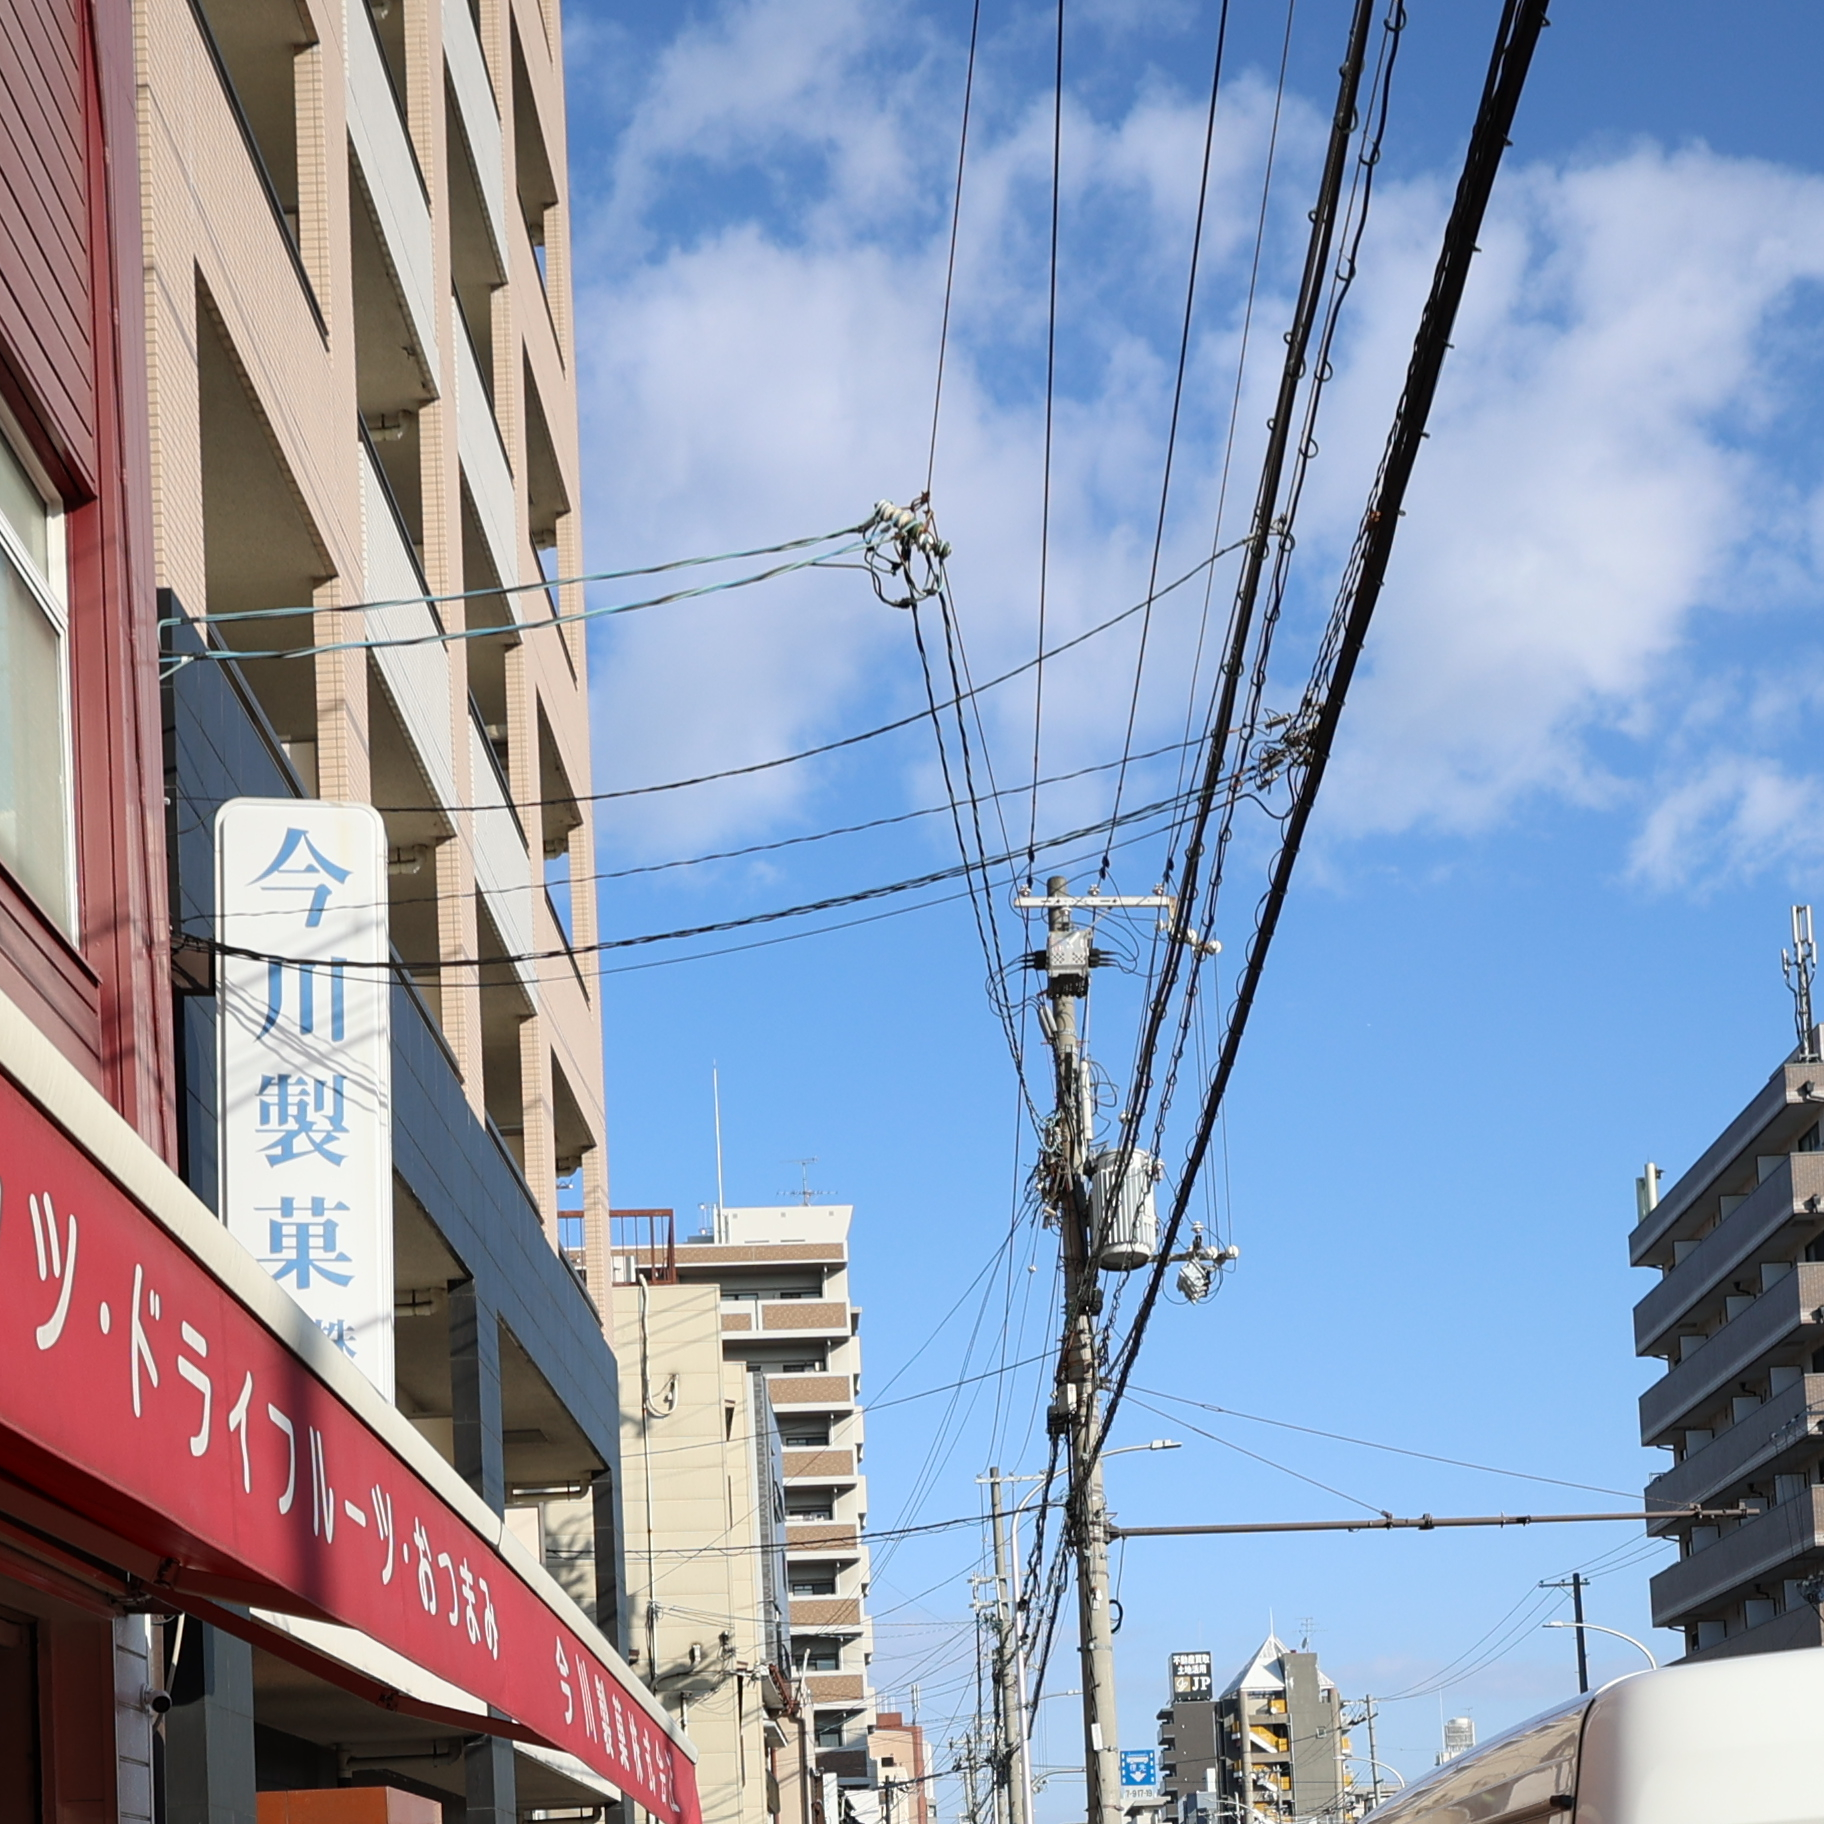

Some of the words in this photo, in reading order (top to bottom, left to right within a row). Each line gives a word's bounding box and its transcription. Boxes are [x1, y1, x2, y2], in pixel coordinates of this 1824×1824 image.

[556, 1635, 681, 1812] 今川製菓株式会社
[1192, 1676, 1211, 1691] JP
